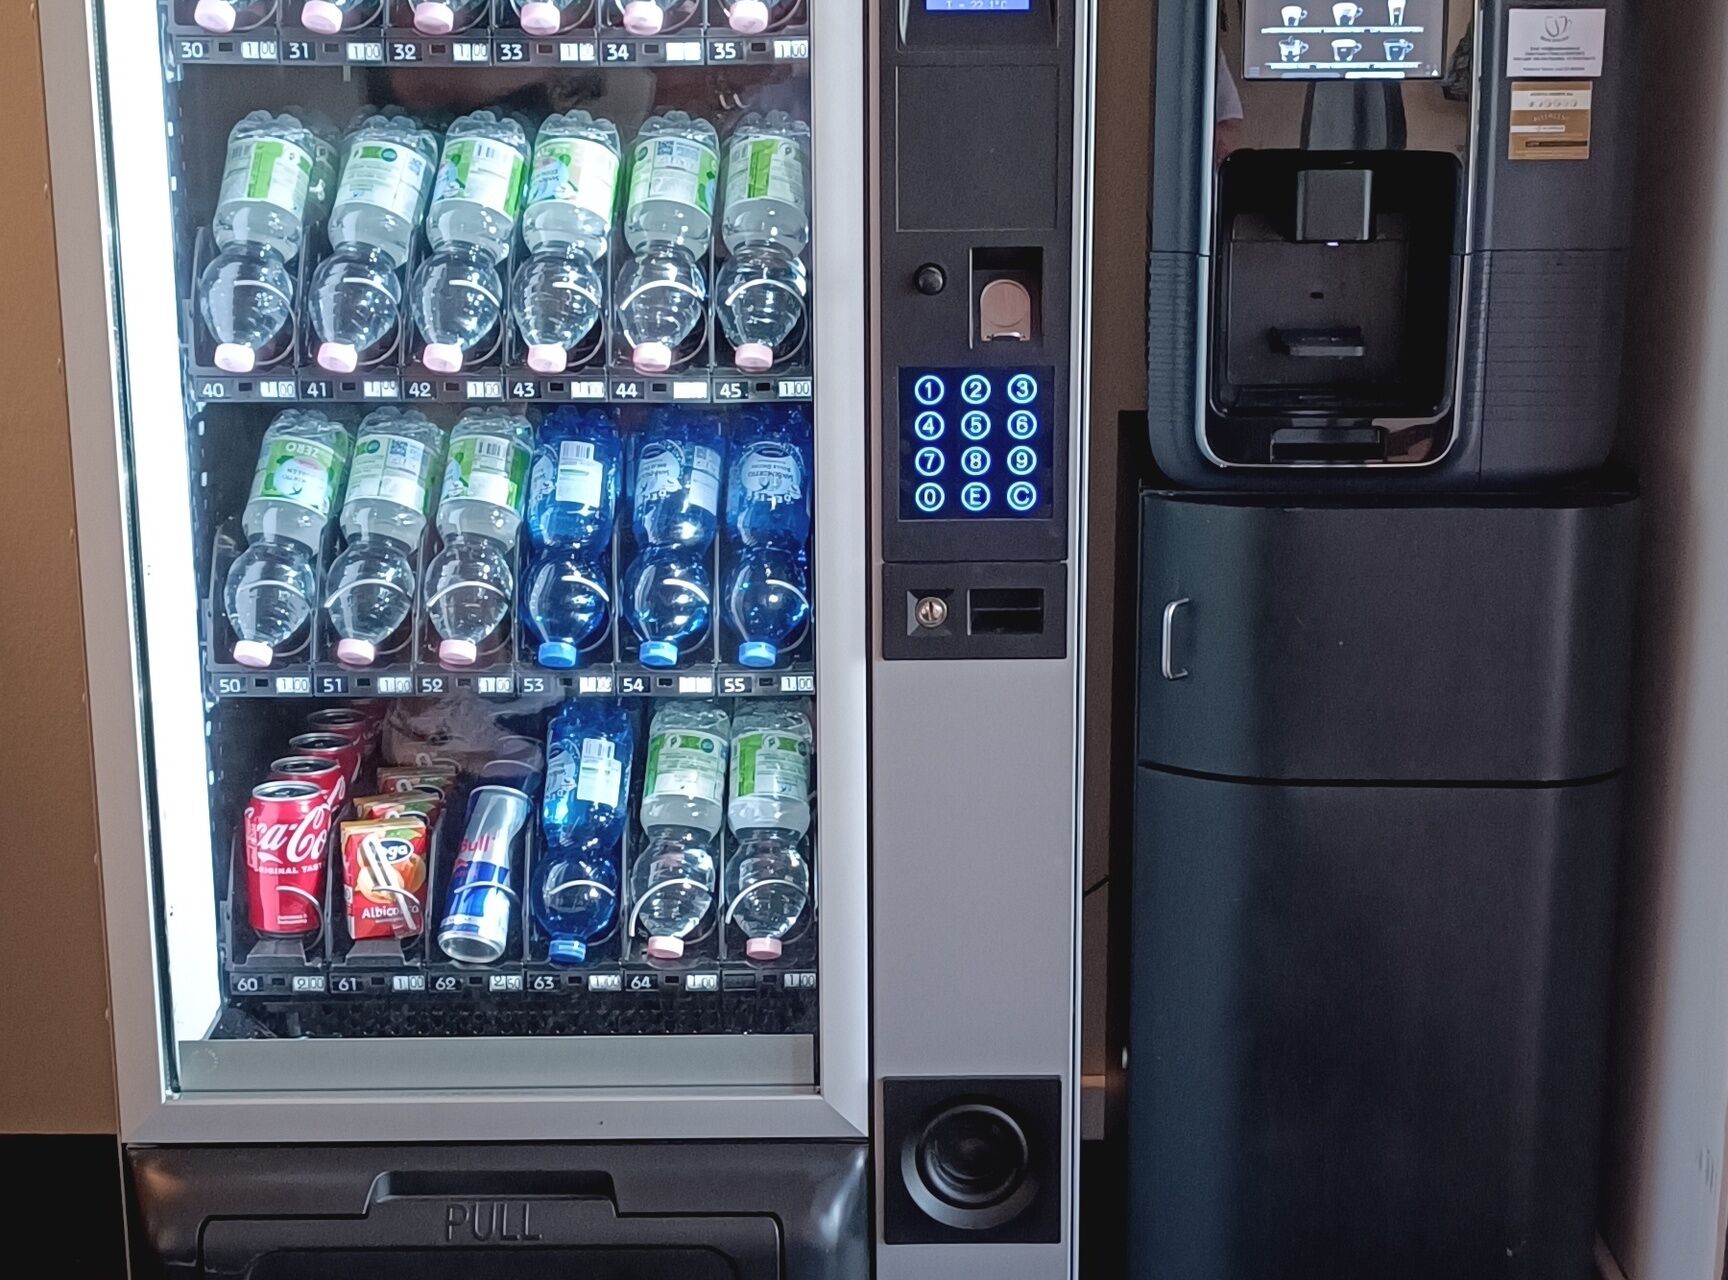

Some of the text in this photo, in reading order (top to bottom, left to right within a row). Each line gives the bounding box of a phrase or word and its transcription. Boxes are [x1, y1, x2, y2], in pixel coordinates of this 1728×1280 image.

[181, 42, 204, 58] 30
[290, 42, 310, 59] 31
[394, 43, 417, 60] 32
[500, 43, 523, 60] 33
[607, 43, 629, 60] 34
[714, 42, 737, 59] 35
[203, 383, 225, 398] 40
[307, 382, 327, 397] 41
[409, 382, 432, 397] 42
[513, 382, 535, 397] 43
[616, 383, 638, 398] 44
[720, 382, 742, 398] 45
[924, 381, 932, 399] 1
[969, 381, 982, 398] 2
[1016, 380, 1029, 398] 3
[922, 416, 935, 435] 4
[970, 416, 982, 433] 5
[1016, 416, 1028, 433] 6
[286, 442, 318, 458] ZERO
[924, 453, 935, 470] 7
[969, 452, 982, 469] 8
[1016, 452, 1028, 469] 9
[924, 488, 936, 505] 0
[970, 487, 982, 505] E
[1013, 486, 1030, 505] C
[219, 678, 241, 693] 50
[323, 678, 342, 693] 51
[422, 678, 443, 693] 52
[523, 678, 544, 693] 53
[623, 678, 645, 693] 54
[725, 677, 745, 693] 55
[301, 862, 323, 874] TAST
[238, 977, 259, 991] 60
[339, 977, 357, 991] 61
[436, 977, 457, 991] 62
[534, 976, 555, 990] 63
[631, 976, 651, 990] 64
[446, 1201, 543, 1242] PULL
